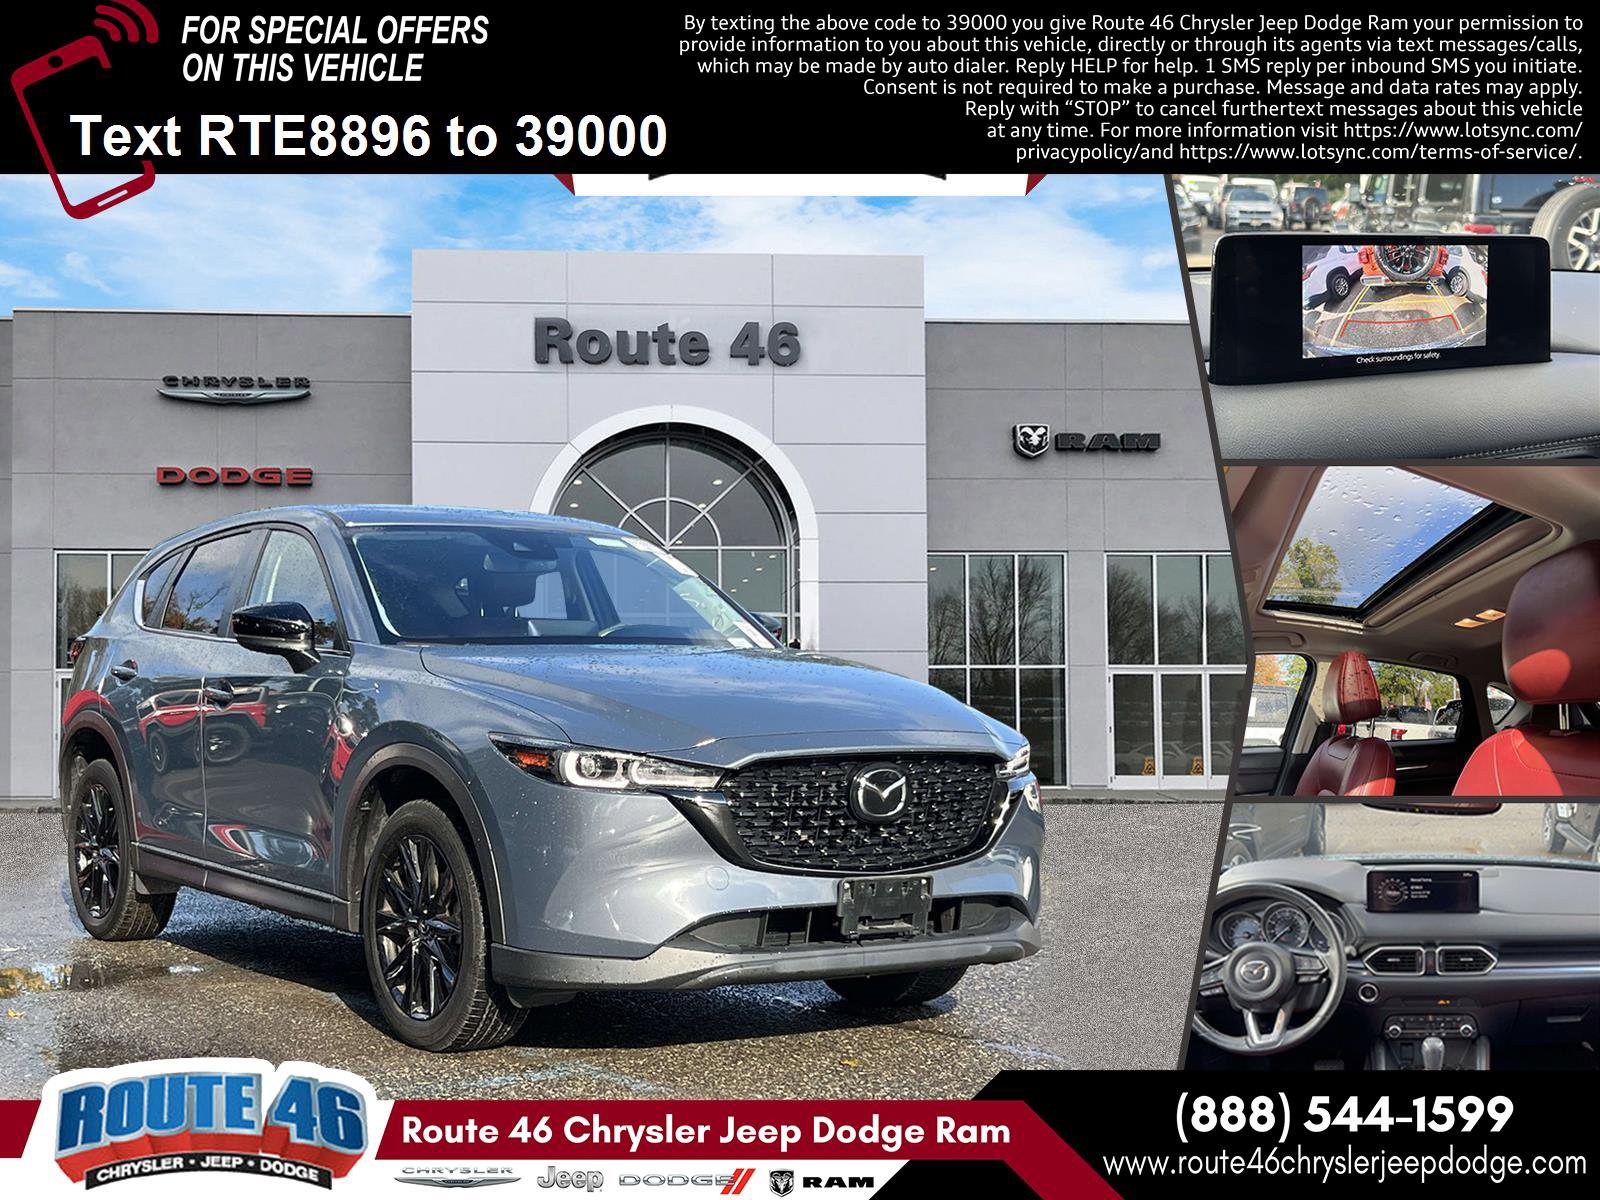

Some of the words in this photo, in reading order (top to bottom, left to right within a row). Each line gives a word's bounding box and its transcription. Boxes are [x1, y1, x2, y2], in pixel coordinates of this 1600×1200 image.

[534, 317, 709, 365] Route
[730, 322, 801, 366] 46
[1356, 356, 1375, 364] Check
[1375, 353, 1414, 362] surroundings
[1414, 352, 1422, 360] for
[162, 375, 310, 388] CHRYSLER
[1055, 432, 1161, 452] RAM
[156, 466, 313, 486] DODGE
